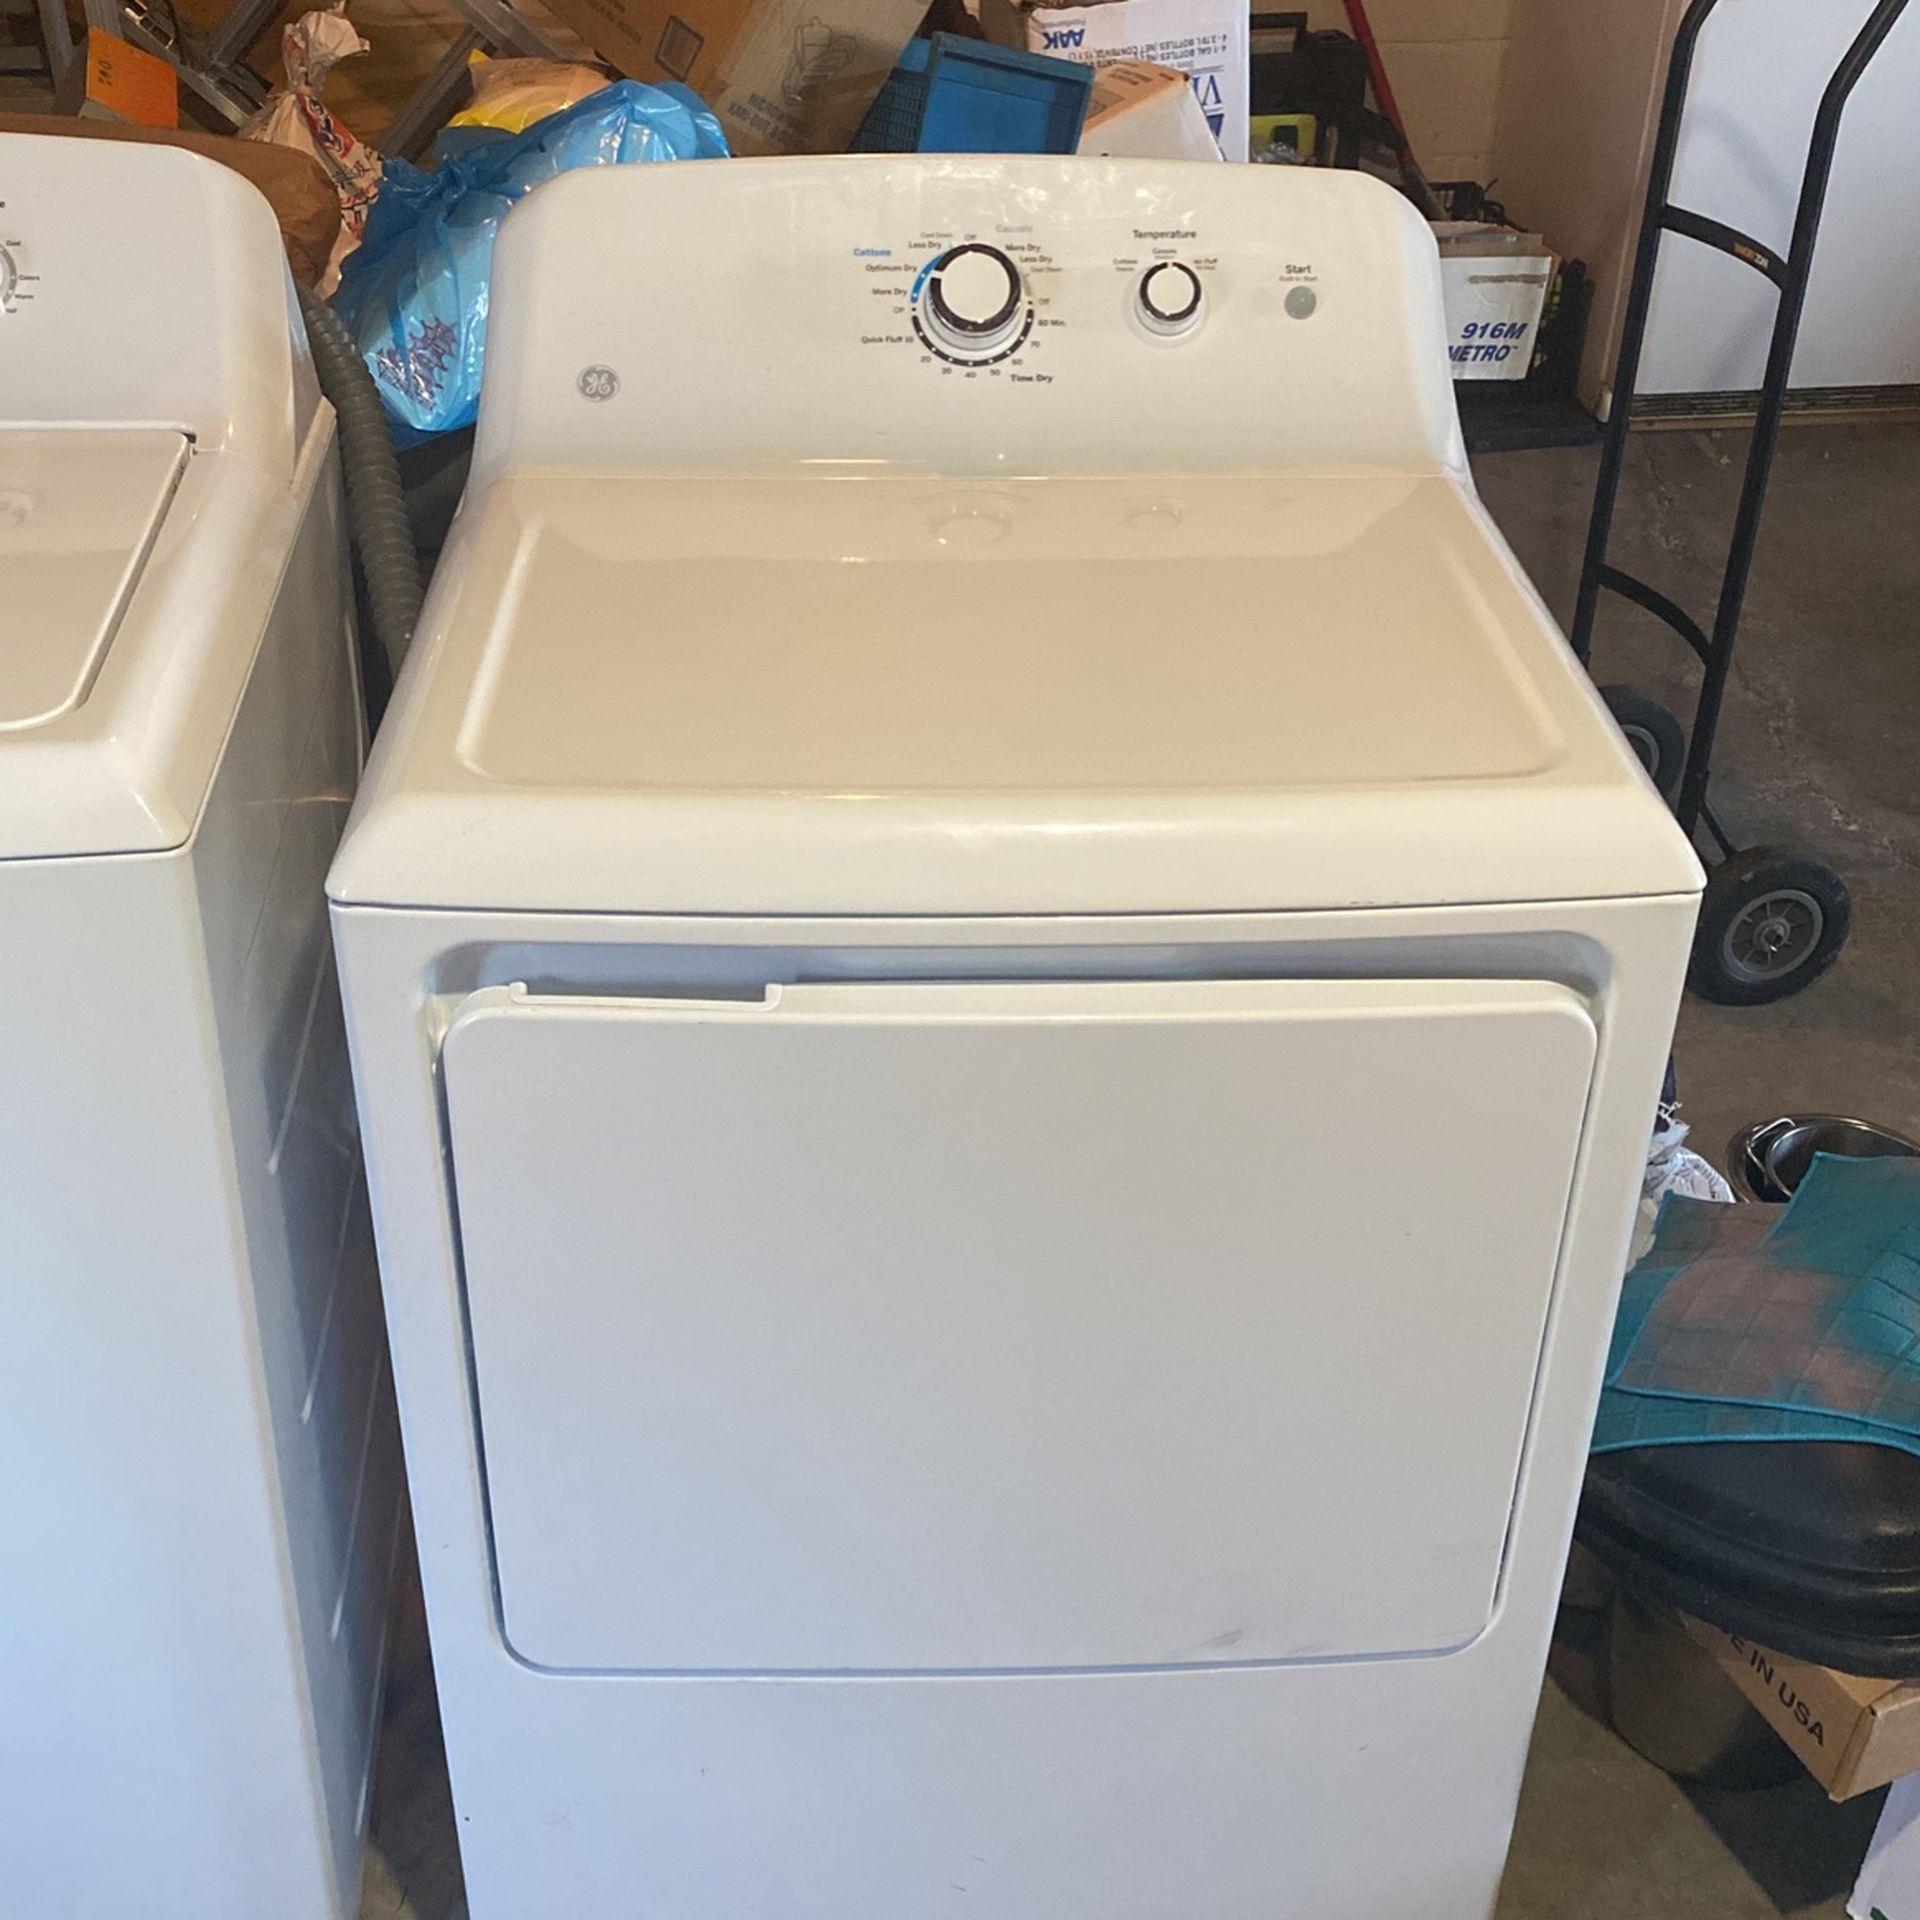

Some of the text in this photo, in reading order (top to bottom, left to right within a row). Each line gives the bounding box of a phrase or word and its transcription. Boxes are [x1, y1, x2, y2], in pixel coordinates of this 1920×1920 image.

[1043, 29, 1086, 50] AAK
[1160, 39, 1195, 51] BOTTLES
[1196, 45, 1211, 55] GAL
[1160, 47, 1195, 61] BOTTLES
[1133, 229, 1196, 240] Temperature
[928, 241, 942, 249] Dry
[1027, 244, 1041, 252] Dry
[853, 248, 891, 257] Cottons
[1020, 255, 1053, 264] Less Dry
[865, 264, 918, 272] Optimum Dry
[1285, 264, 1312, 274] Start
[894, 288, 907, 297] Dry
[1461, 322, 1529, 340] 916M
[861, 336, 883, 344] Quick
[941, 367, 952, 375] 30
[1010, 374, 1054, 384] Time Dry
[1750, 1649, 1774, 1685] IN
[1778, 1681, 1824, 1747] USA
